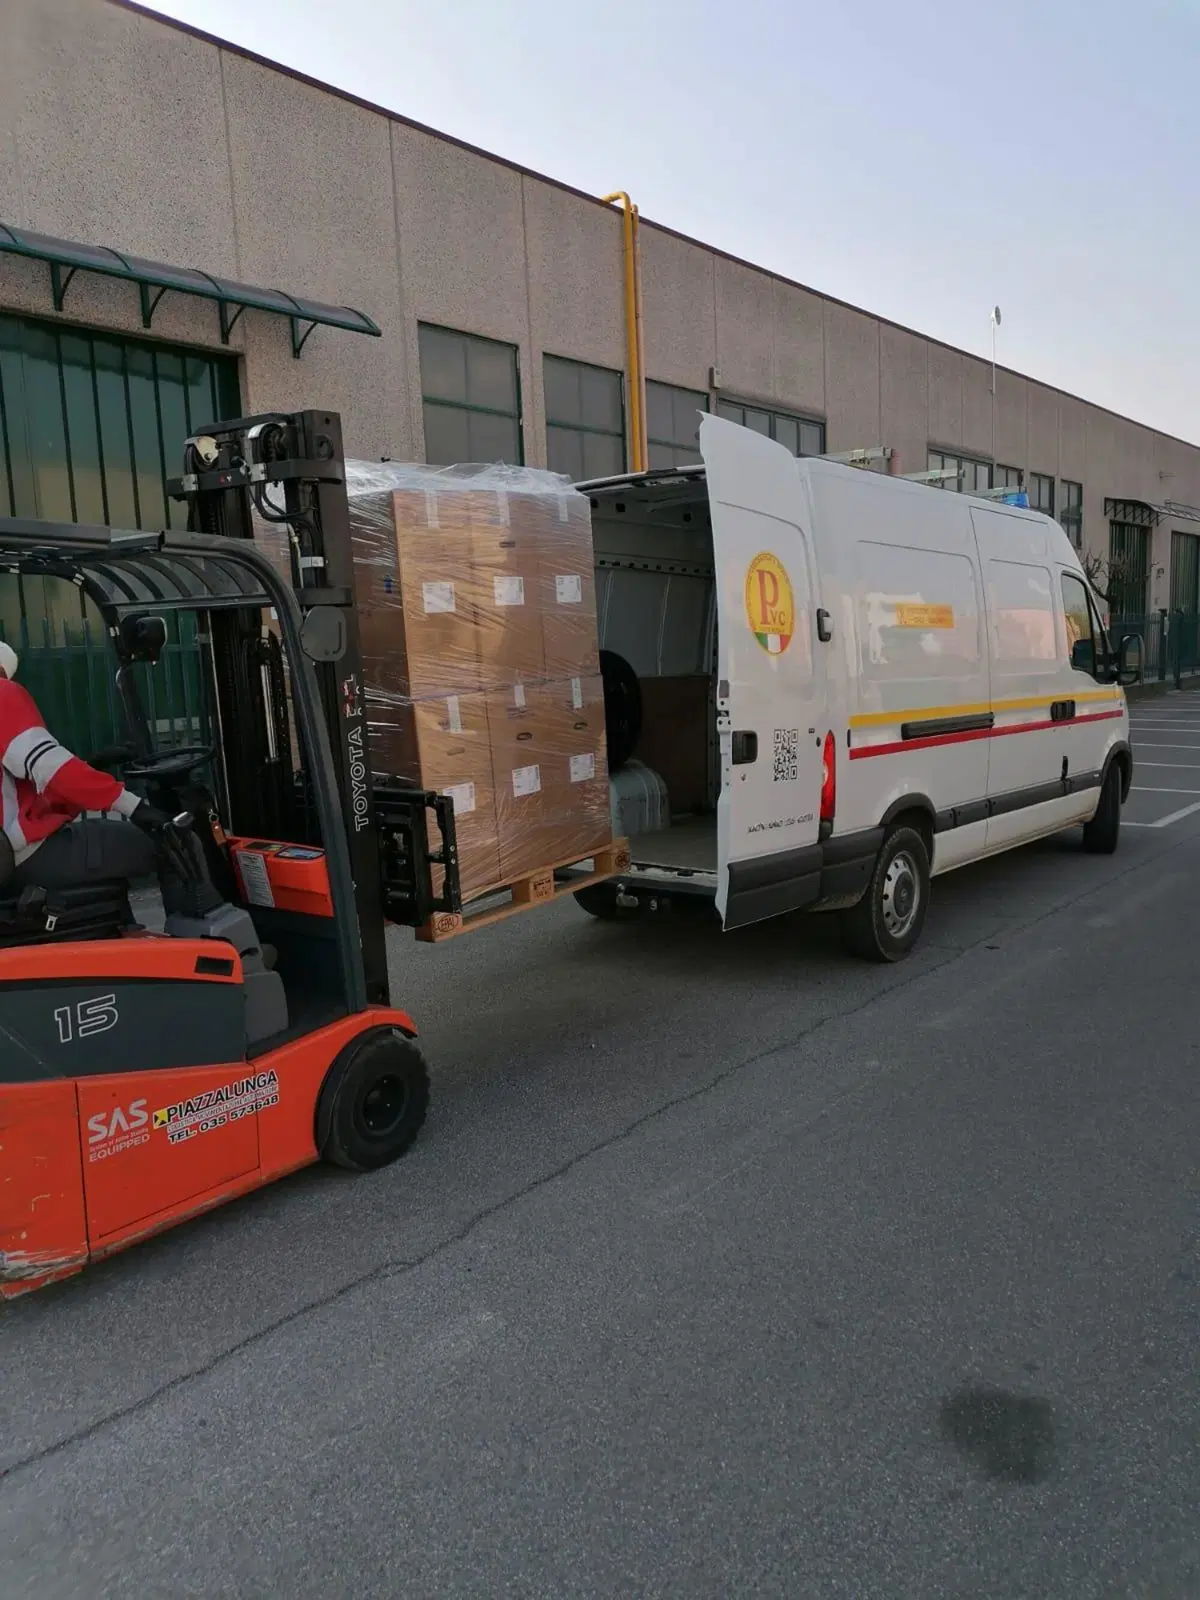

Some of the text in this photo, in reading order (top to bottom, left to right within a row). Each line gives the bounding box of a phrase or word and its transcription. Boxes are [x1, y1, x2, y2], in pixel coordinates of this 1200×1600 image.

[347, 725, 369, 832] TOYOTA
[54, 994, 119, 1044] 15
[166, 1071, 277, 1123] PIAZZALUNGA
[168, 1095, 279, 1144] TEL. 035 573648
[88, 1099, 148, 1145] SAS
[89, 1133, 150, 1162] EQUIPPED
